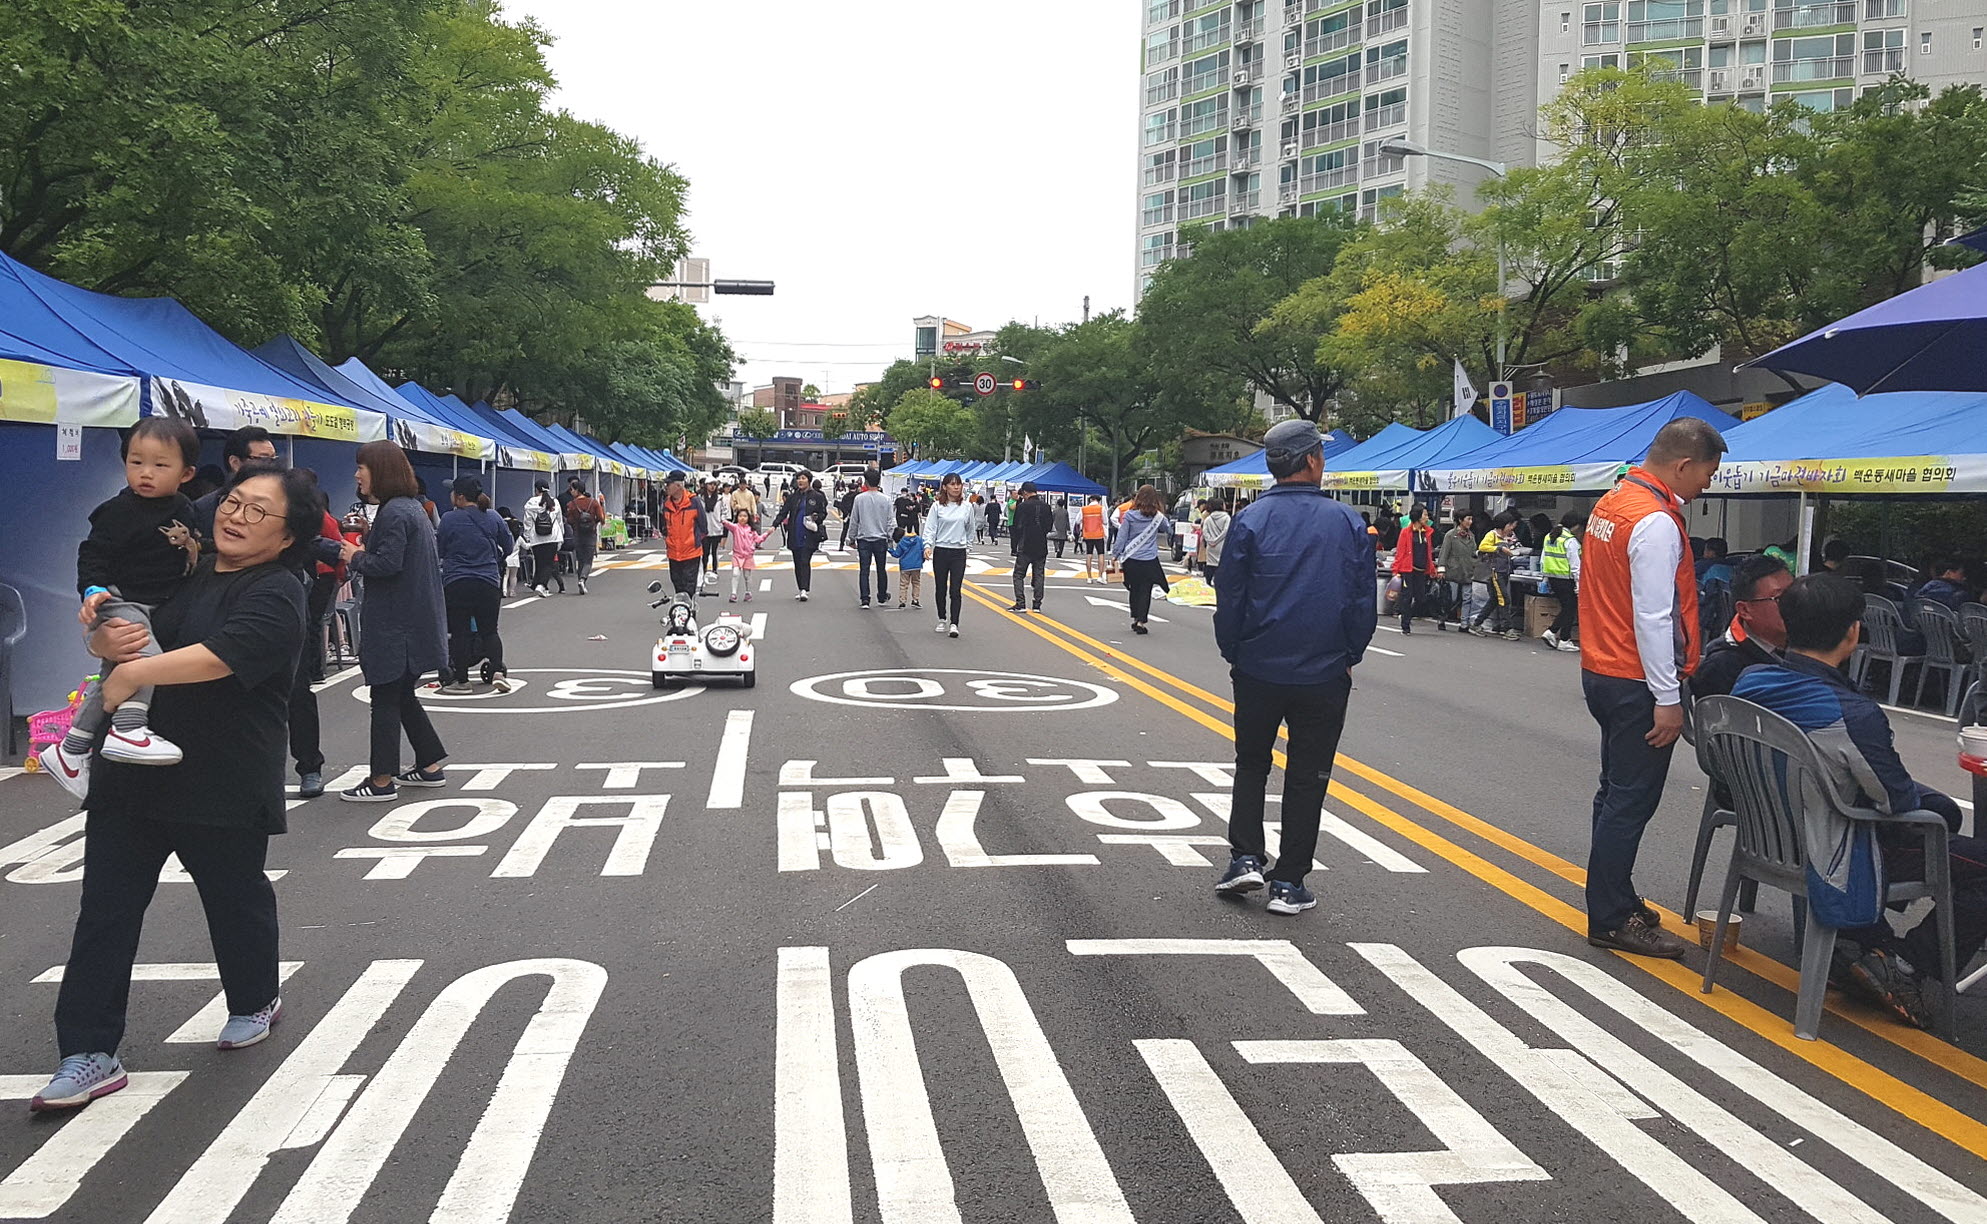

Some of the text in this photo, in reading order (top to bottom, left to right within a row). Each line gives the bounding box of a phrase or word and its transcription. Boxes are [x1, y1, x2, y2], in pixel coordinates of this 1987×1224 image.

[979, 379, 992, 389] 30
[852, 433, 869, 441] AUTO
[1713, 465, 1957, 490] 이웃돕기 기금마련바자회 백운동새마을 협의회
[842, 677, 1072, 701] 30
